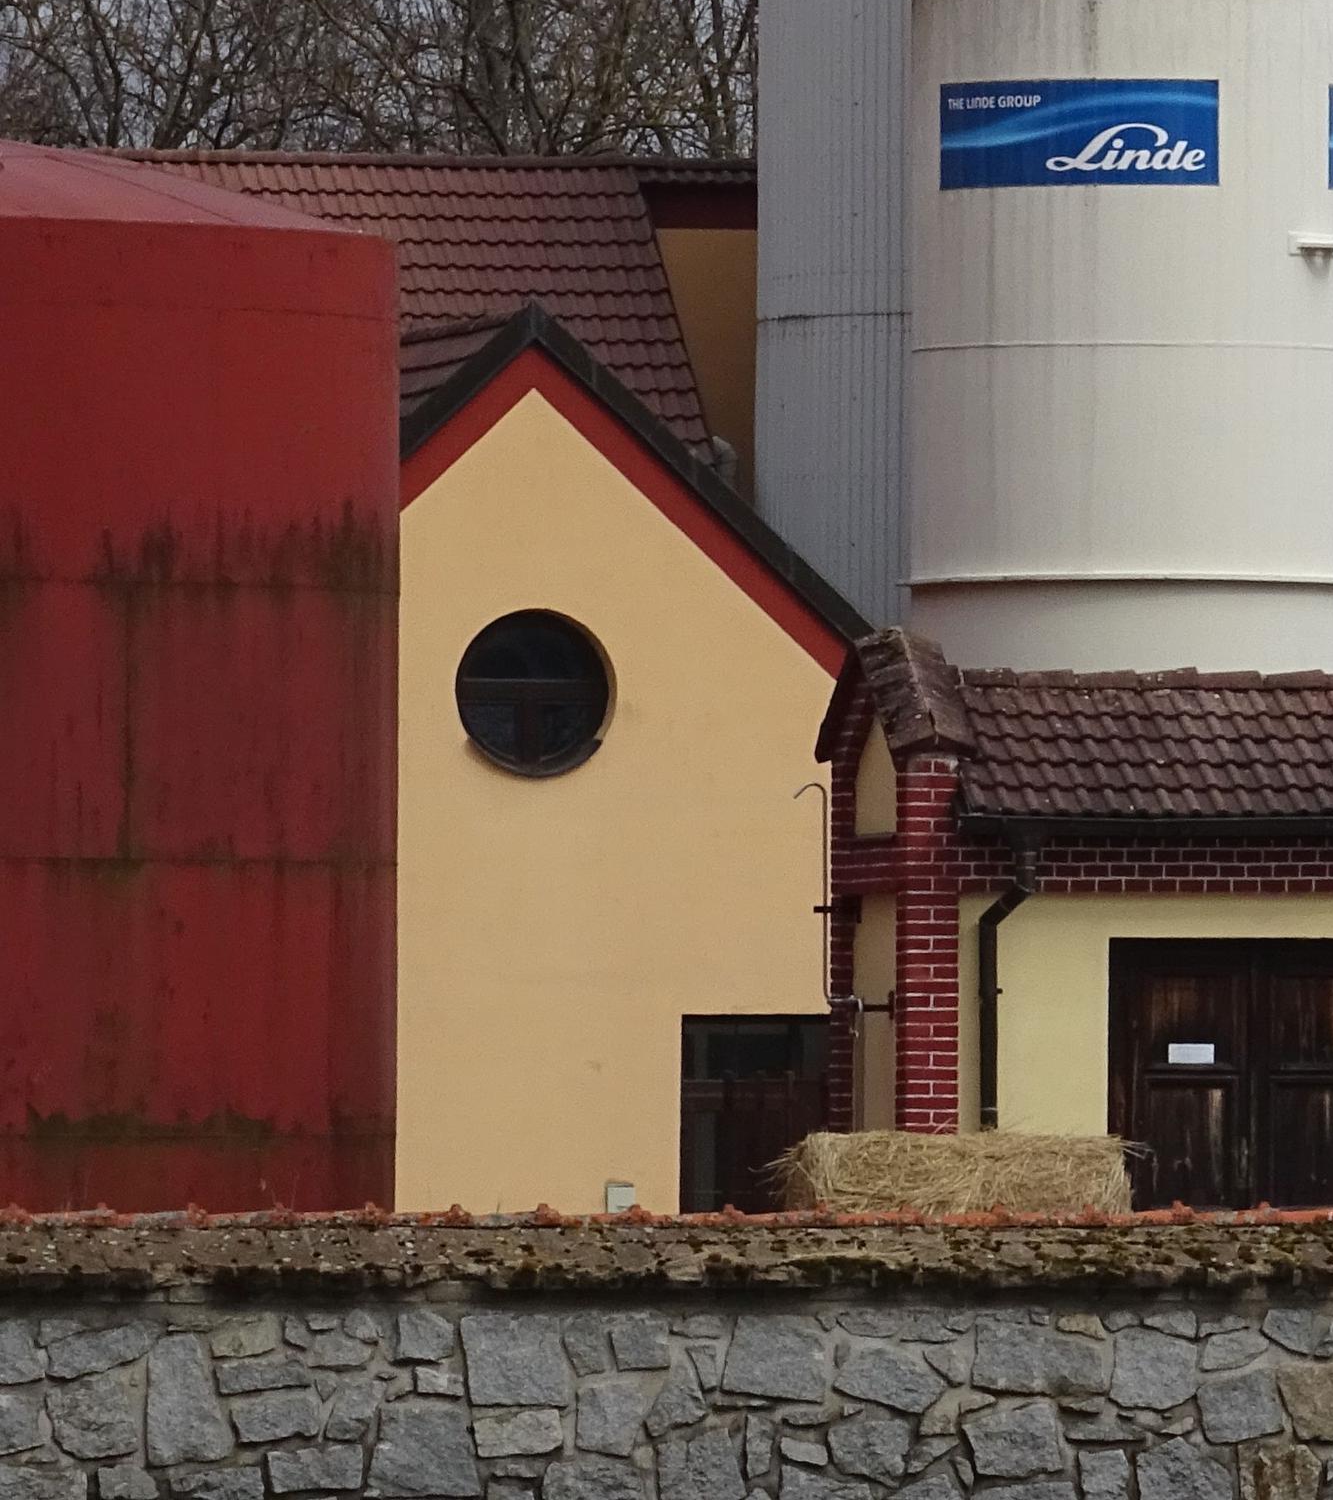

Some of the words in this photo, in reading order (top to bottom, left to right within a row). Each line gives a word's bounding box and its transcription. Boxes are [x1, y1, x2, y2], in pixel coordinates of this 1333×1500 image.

[948, 98, 964, 110] THE
[966, 96, 995, 109] LINDE
[998, 95, 1041, 108] GROUP
[1045, 122, 1205, 171] Linde
